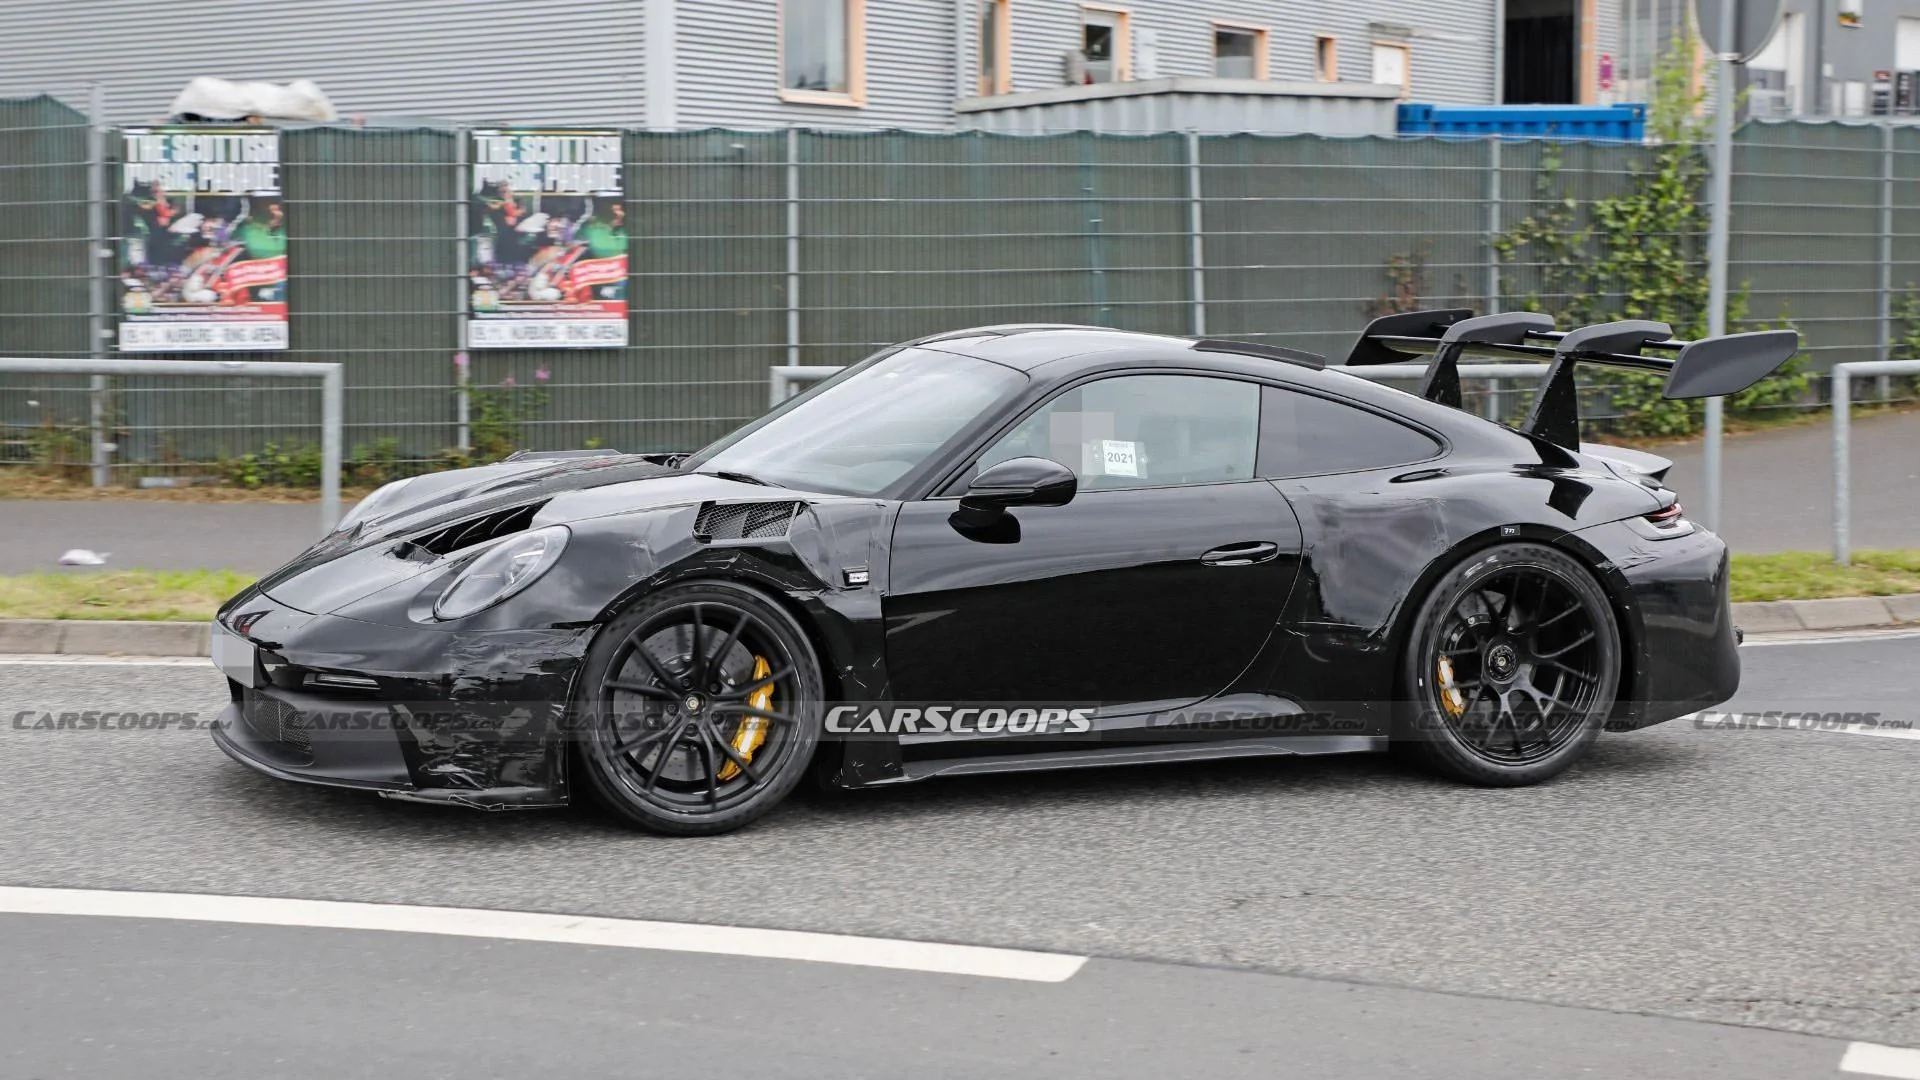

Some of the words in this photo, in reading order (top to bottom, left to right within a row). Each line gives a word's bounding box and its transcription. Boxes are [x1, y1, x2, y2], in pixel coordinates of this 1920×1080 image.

[123, 134, 169, 162] THE
[172, 134, 279, 162] SCOTTISH
[472, 135, 519, 163] THE
[519, 135, 622, 163] SCOTTISH
[1107, 451, 1133, 464] 2021
